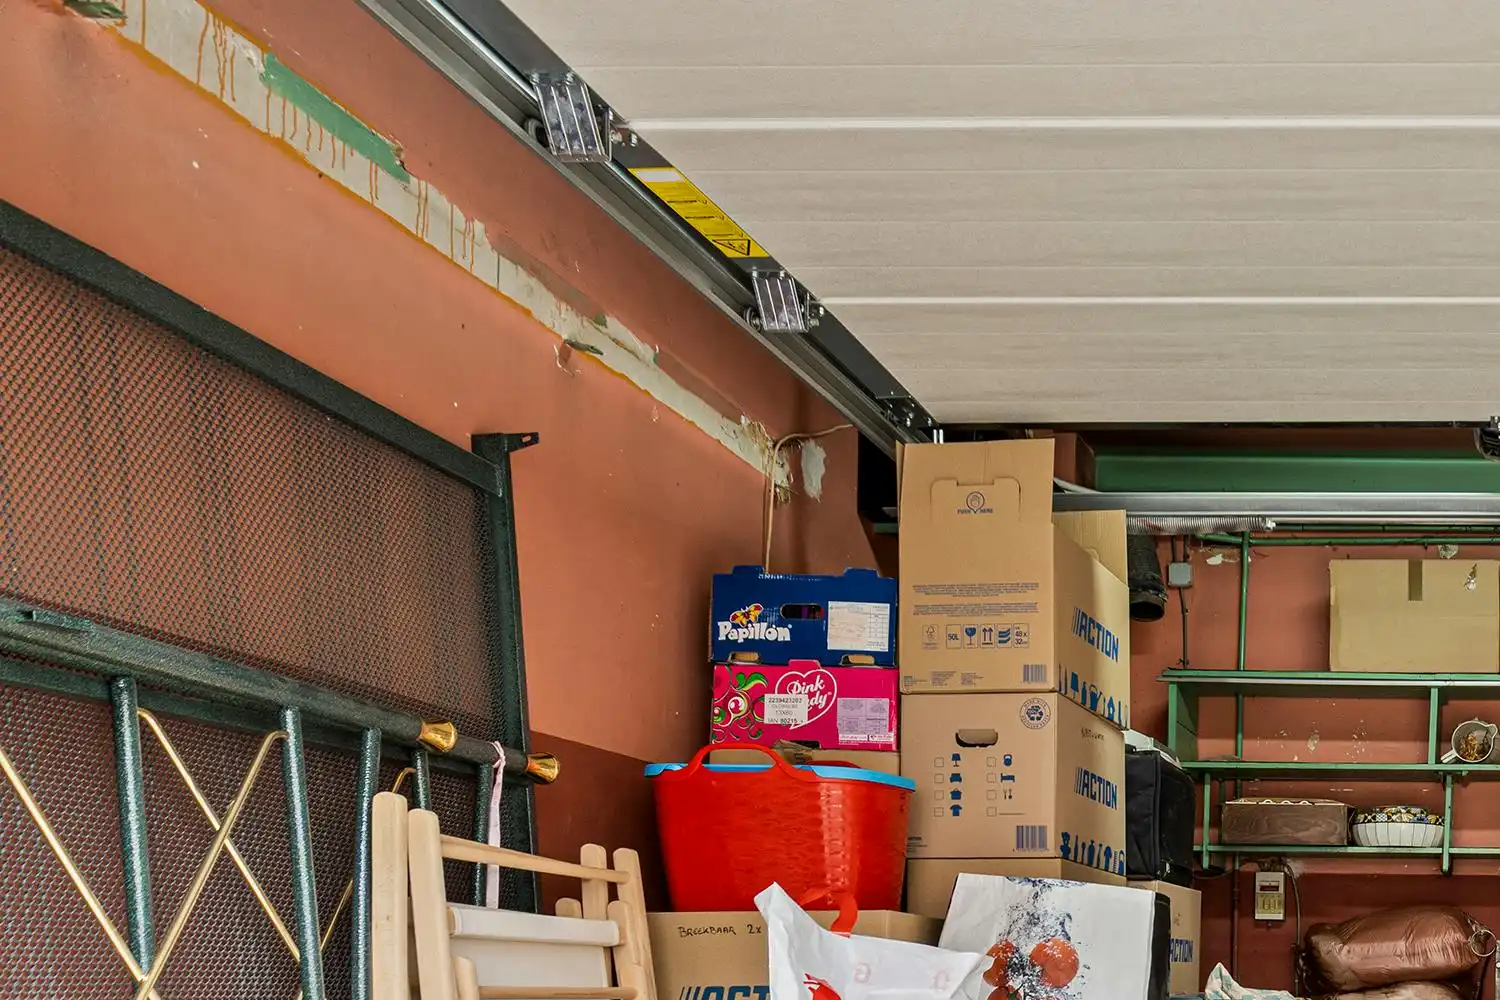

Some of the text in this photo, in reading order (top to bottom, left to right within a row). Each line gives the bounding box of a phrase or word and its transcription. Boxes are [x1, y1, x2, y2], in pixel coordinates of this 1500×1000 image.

[1079, 610, 1119, 663] ACTION
[1082, 770, 1118, 810] ACTION
[678, 924, 737, 938] BREEKBAAR
